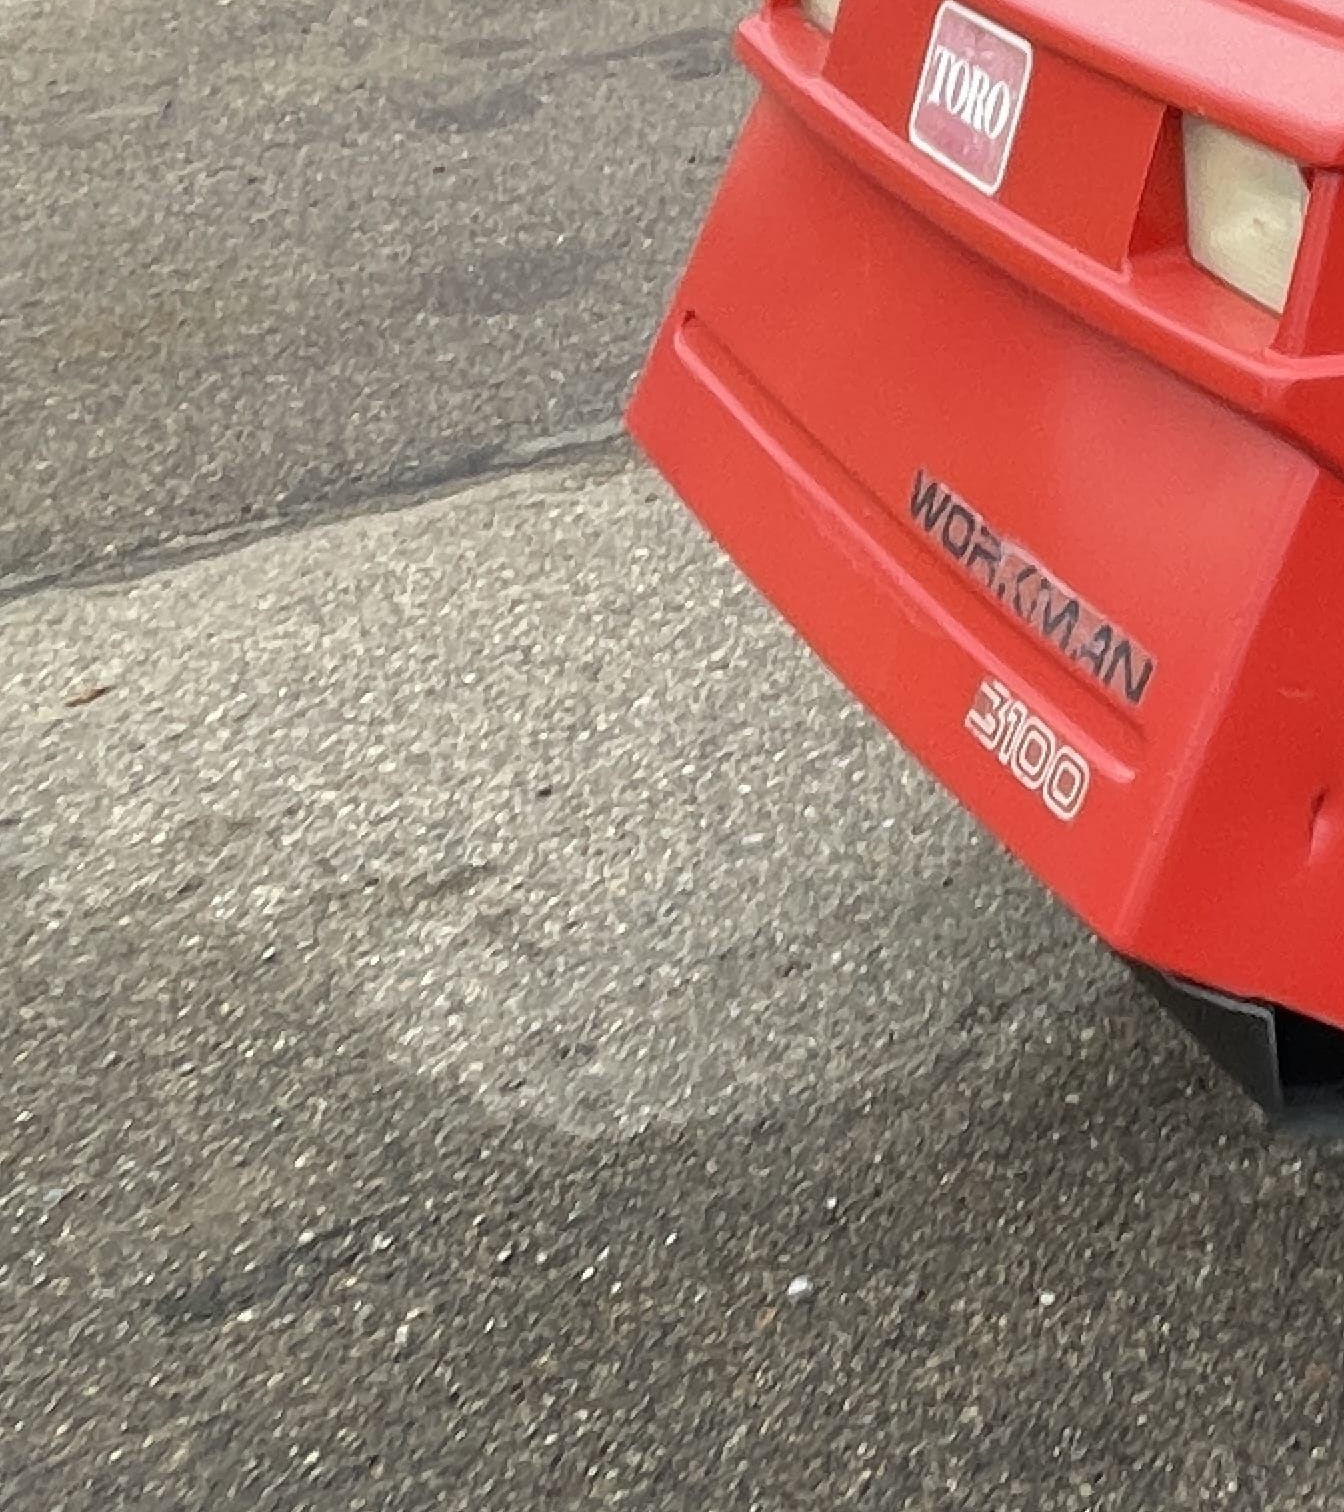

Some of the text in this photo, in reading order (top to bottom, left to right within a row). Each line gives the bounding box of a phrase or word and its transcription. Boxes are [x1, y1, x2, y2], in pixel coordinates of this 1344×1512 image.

[927, 44, 1010, 139] TORO
[910, 468, 1155, 704] WORKMAN
[964, 678, 1090, 821] 3100
